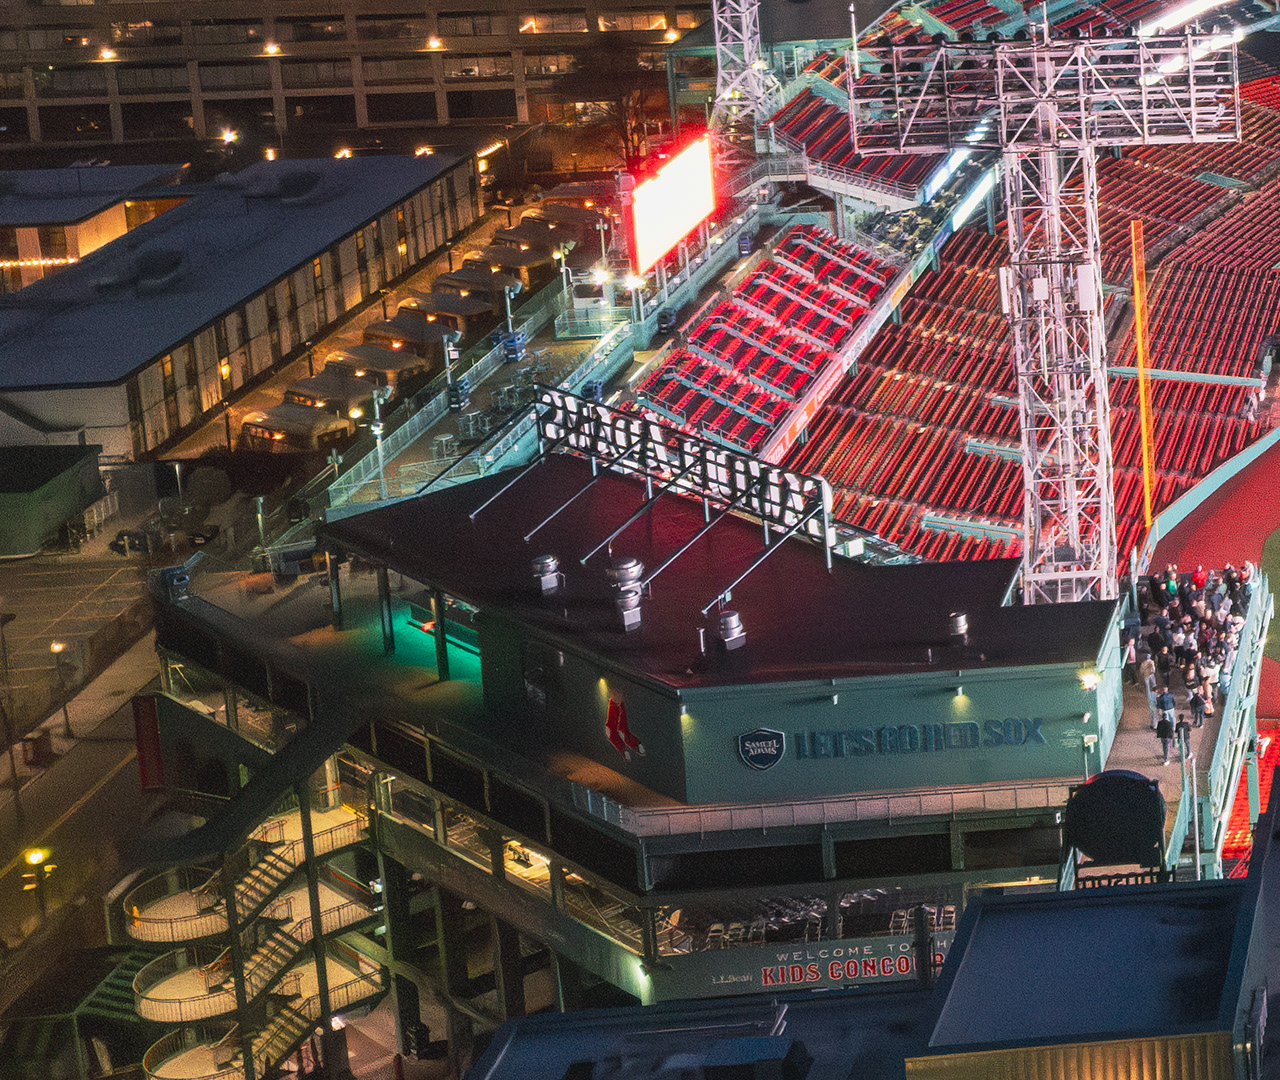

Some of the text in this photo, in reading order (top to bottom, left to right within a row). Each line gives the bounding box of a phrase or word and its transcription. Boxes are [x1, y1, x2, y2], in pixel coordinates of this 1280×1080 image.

[921, 721, 980, 752] RED
[983, 716, 1047, 747] SOX
[744, 739, 781, 750] SAMUEL
[748, 746, 777, 757] ADAMS
[776, 943, 910, 962] WELCOME TO
[762, 963, 821, 986] KIDS
